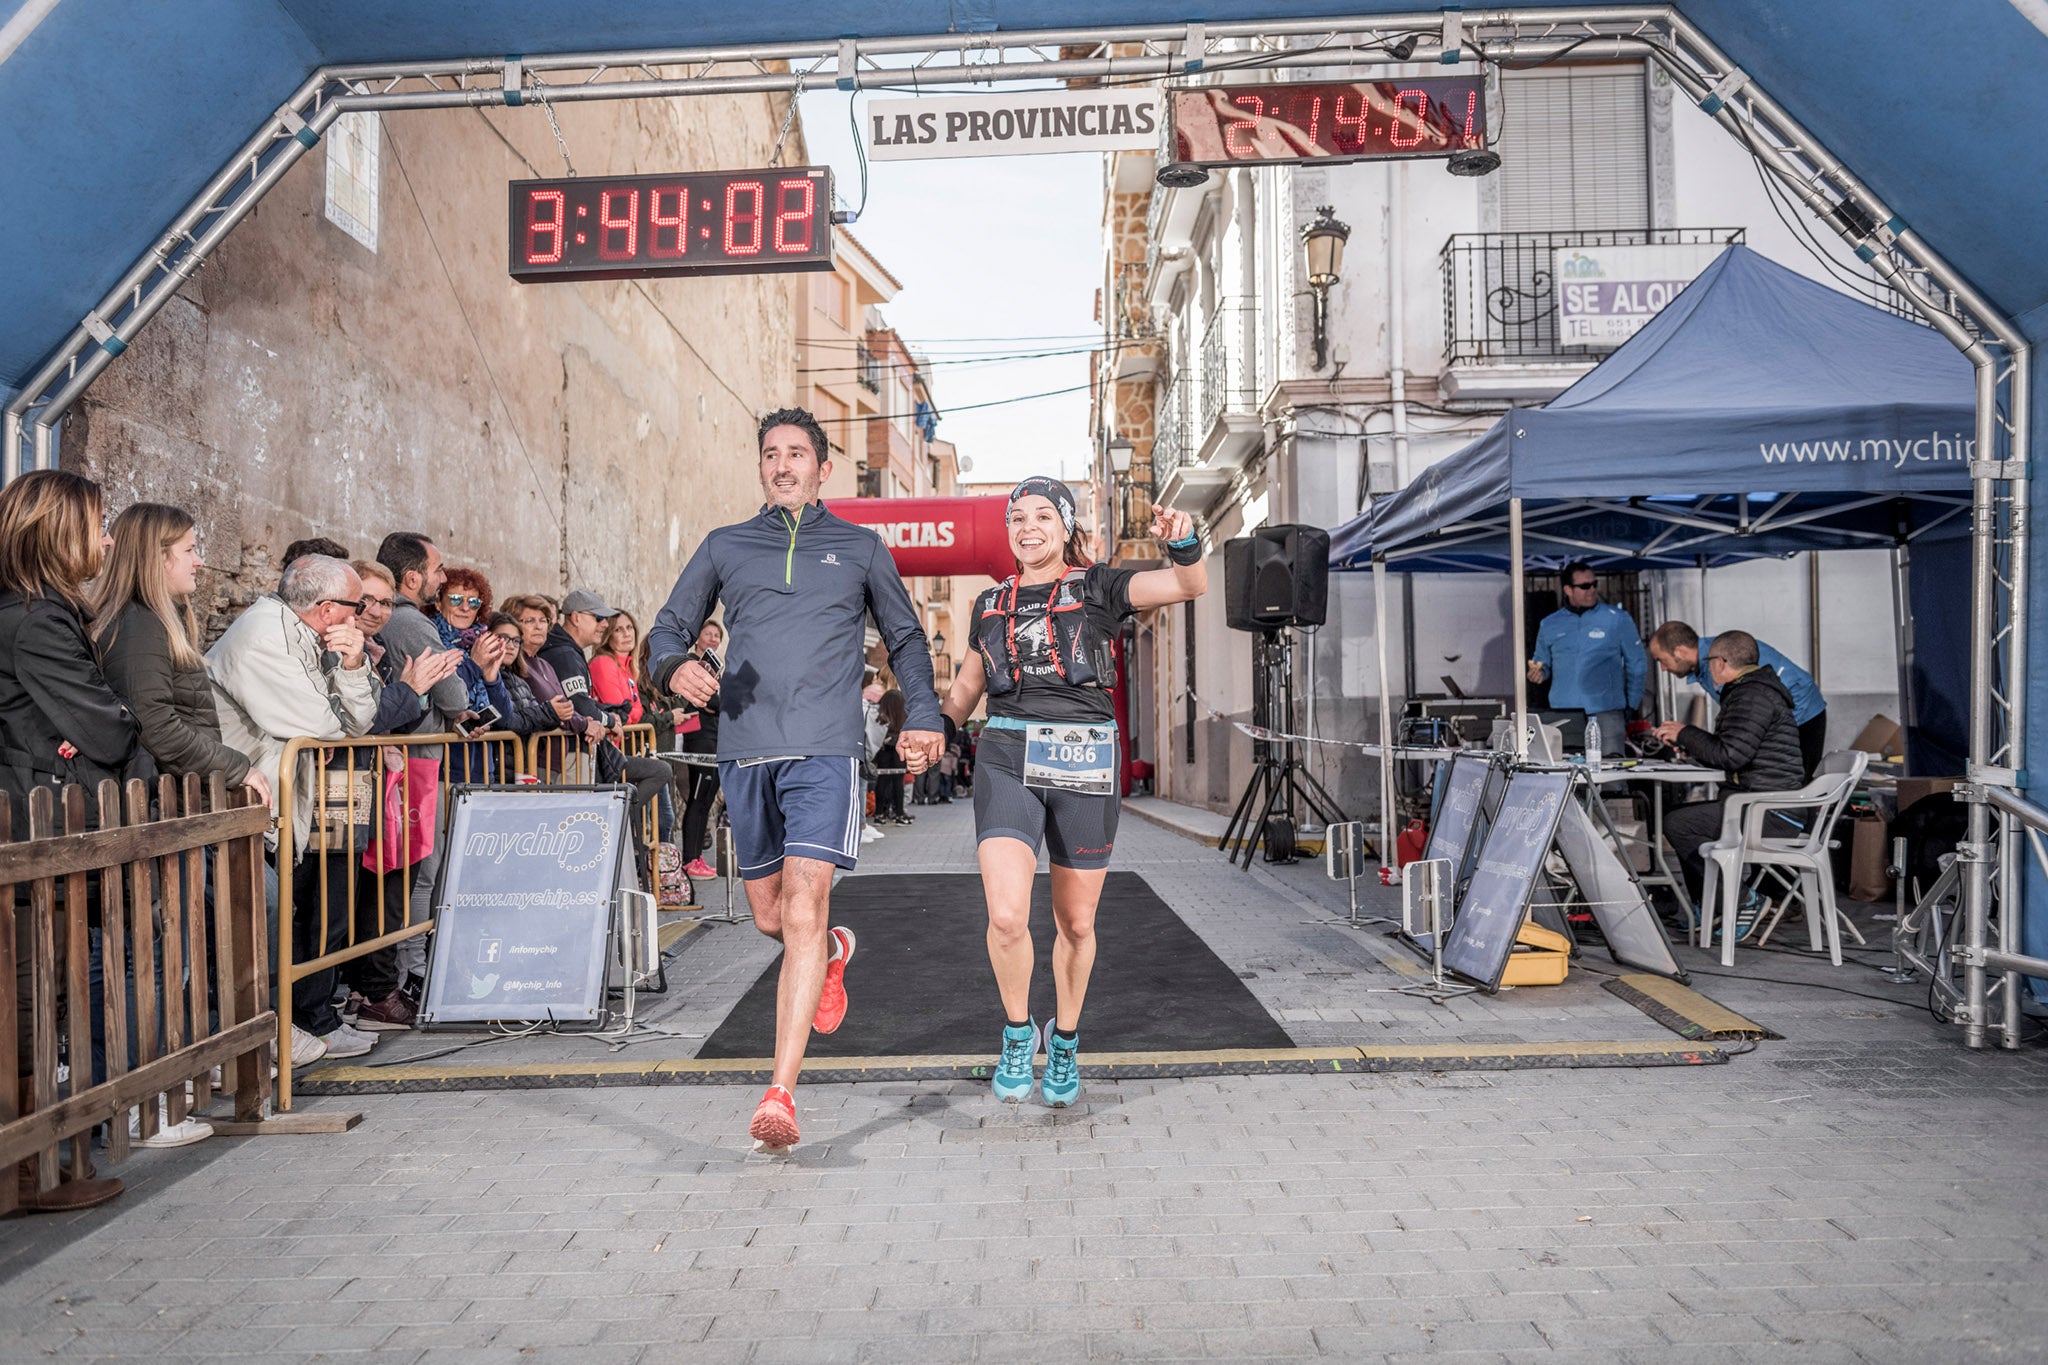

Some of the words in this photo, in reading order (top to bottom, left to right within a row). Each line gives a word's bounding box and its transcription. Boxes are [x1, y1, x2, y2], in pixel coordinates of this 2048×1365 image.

[873, 112, 938, 146] LAS
[945, 102, 1156, 143] PROVINCIAS
[526, 178, 815, 265] 3:44:02
[1566, 284, 1600, 314] SE
[1611, 281, 1690, 314] ALQU
[858, 521, 955, 549] NCIAS
[1017, 602, 1040, 613] CLUB
[1047, 745, 1097, 763] 1086
[464, 822, 585, 865] mychip
[456, 888, 599, 911] www.mychip.es
[502, 980, 563, 992] @Mychip_Info
